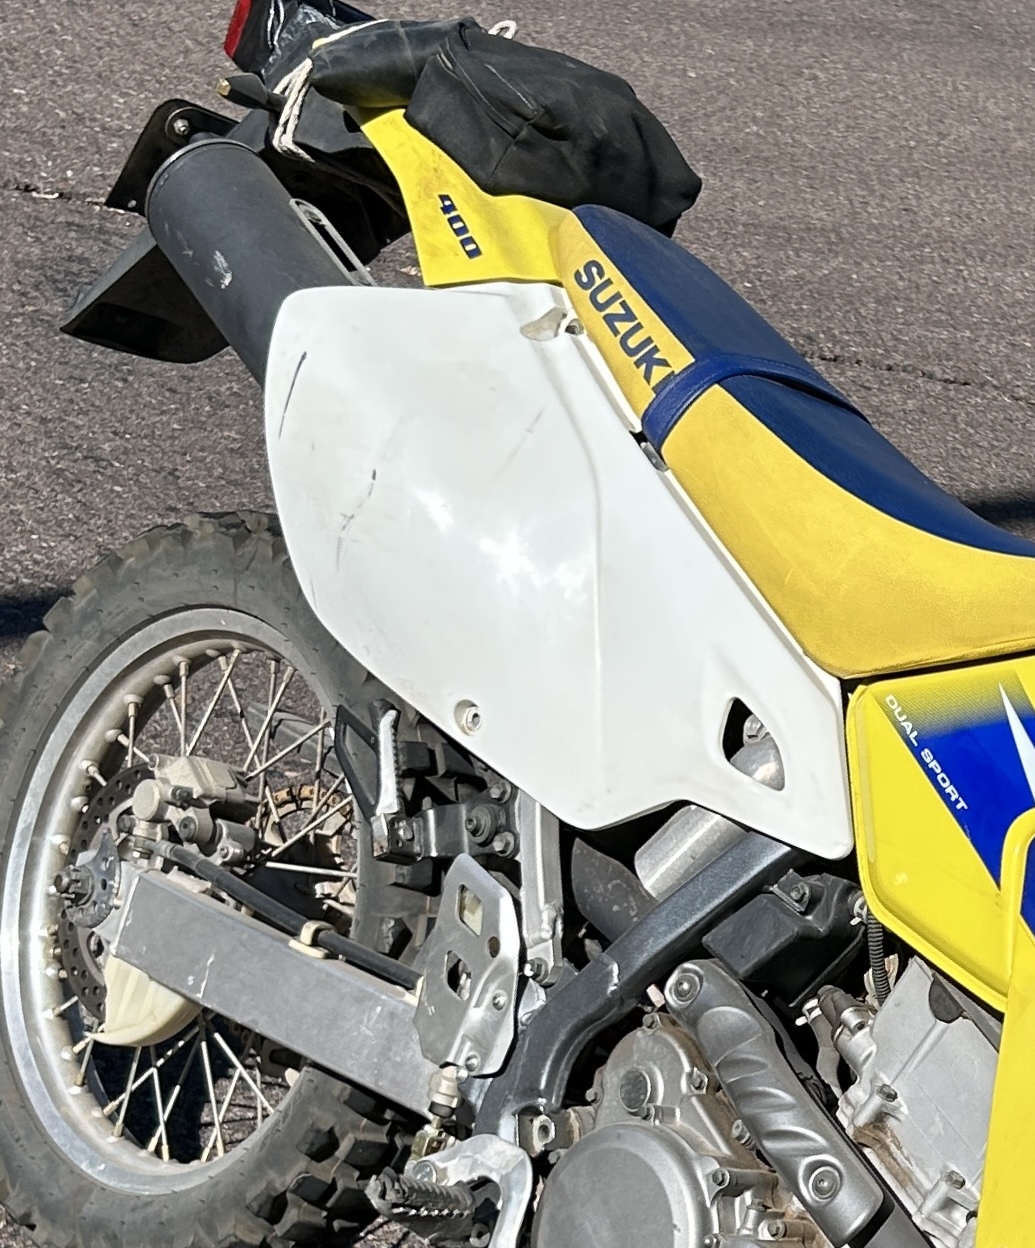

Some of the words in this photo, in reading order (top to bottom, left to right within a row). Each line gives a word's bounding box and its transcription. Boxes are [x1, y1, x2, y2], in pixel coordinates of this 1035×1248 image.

[438, 194, 482, 260] 400
[885, 694, 918, 747] DUAL
[920, 748, 968, 810] SPORT
